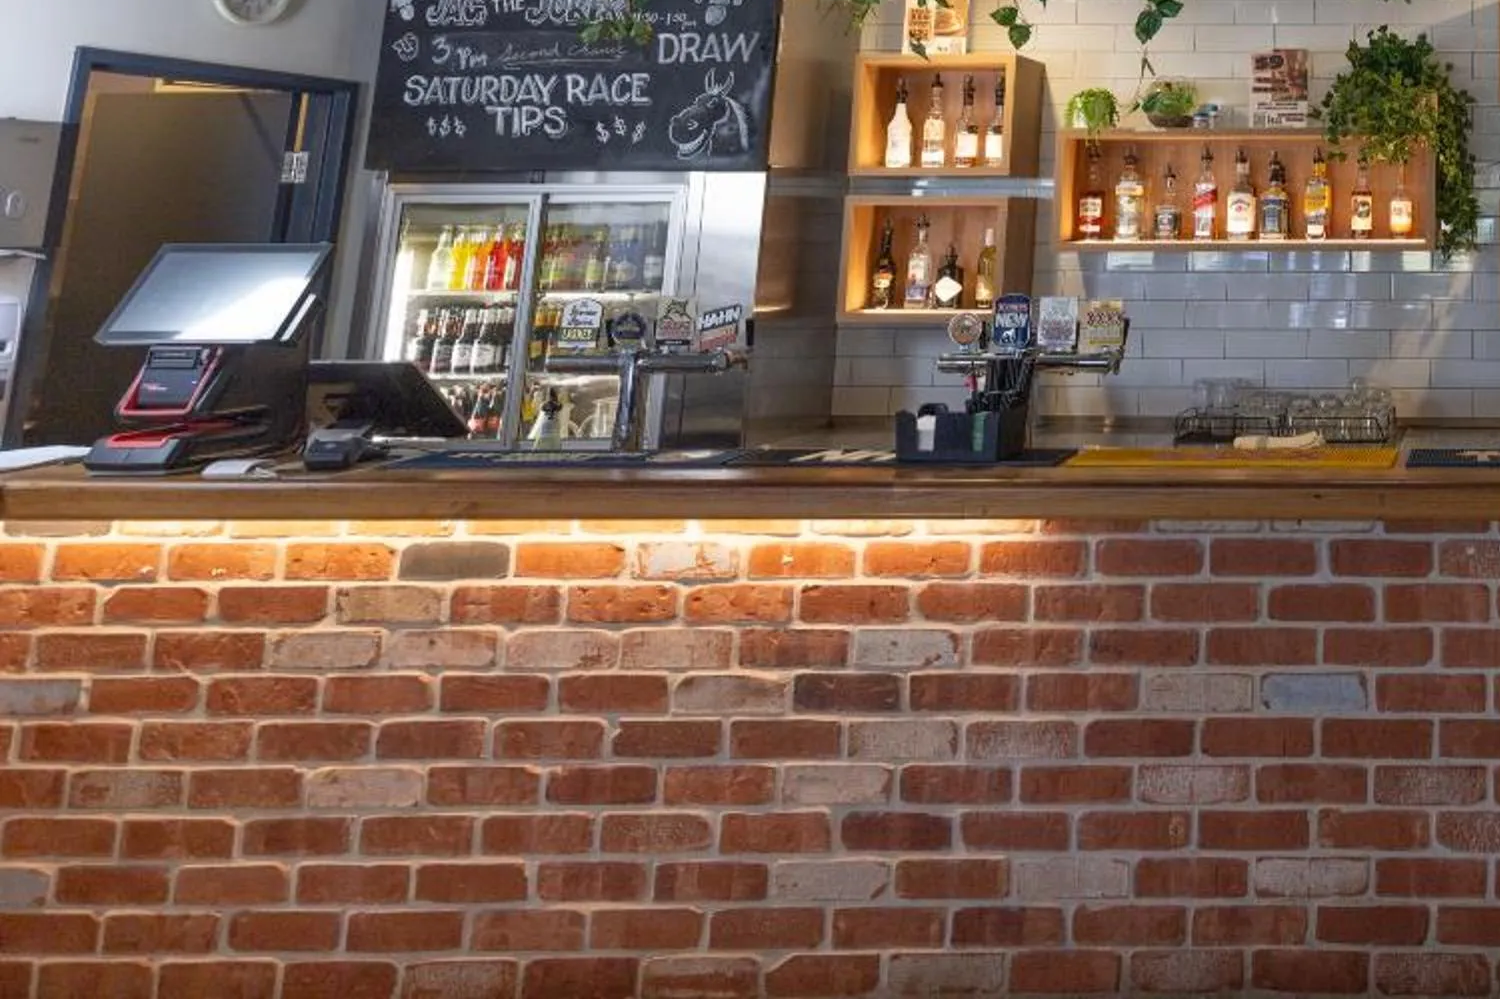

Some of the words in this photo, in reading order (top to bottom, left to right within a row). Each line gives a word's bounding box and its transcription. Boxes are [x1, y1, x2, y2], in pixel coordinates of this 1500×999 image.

[657, 32, 760, 64] DRAW
[404, 74, 558, 106] SATURDAY
[566, 73, 652, 106] RACE
[485, 105, 569, 139] TIPS
[995, 312, 1028, 328] NEW
